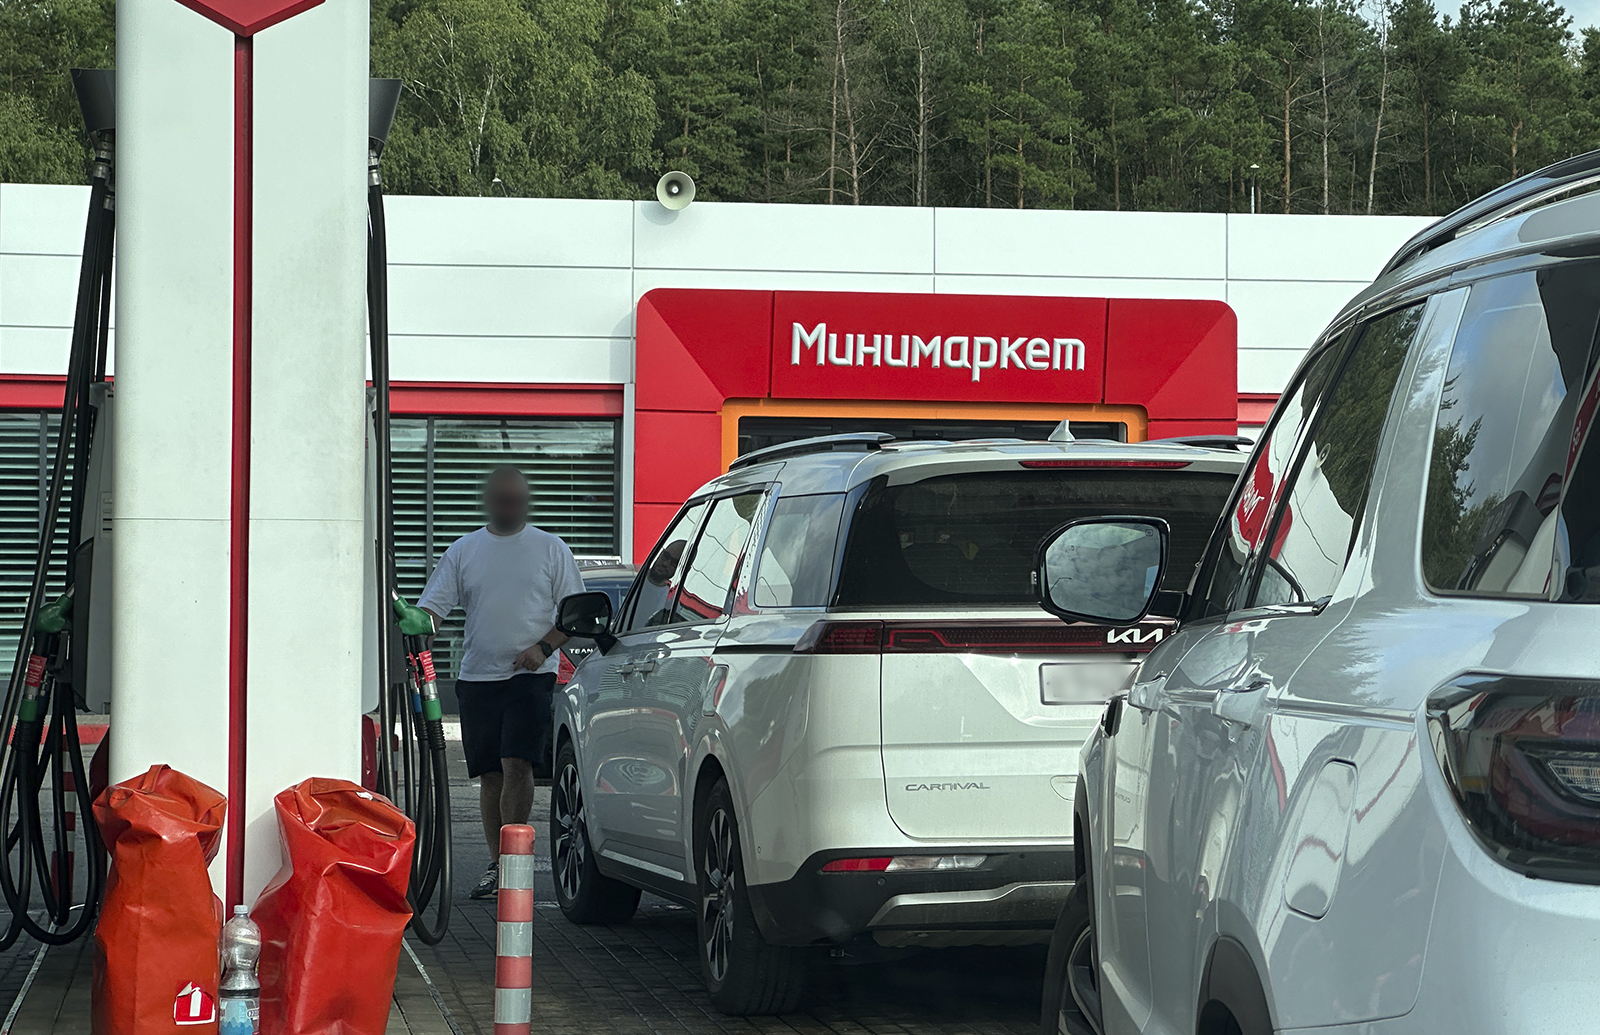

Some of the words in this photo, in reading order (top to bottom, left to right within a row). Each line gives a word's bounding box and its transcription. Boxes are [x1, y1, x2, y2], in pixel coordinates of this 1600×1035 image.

[791, 322, 1086, 382] Минимаркет
[1107, 628, 1163, 643] KIA
[905, 782, 990, 791] CARNIVAL
